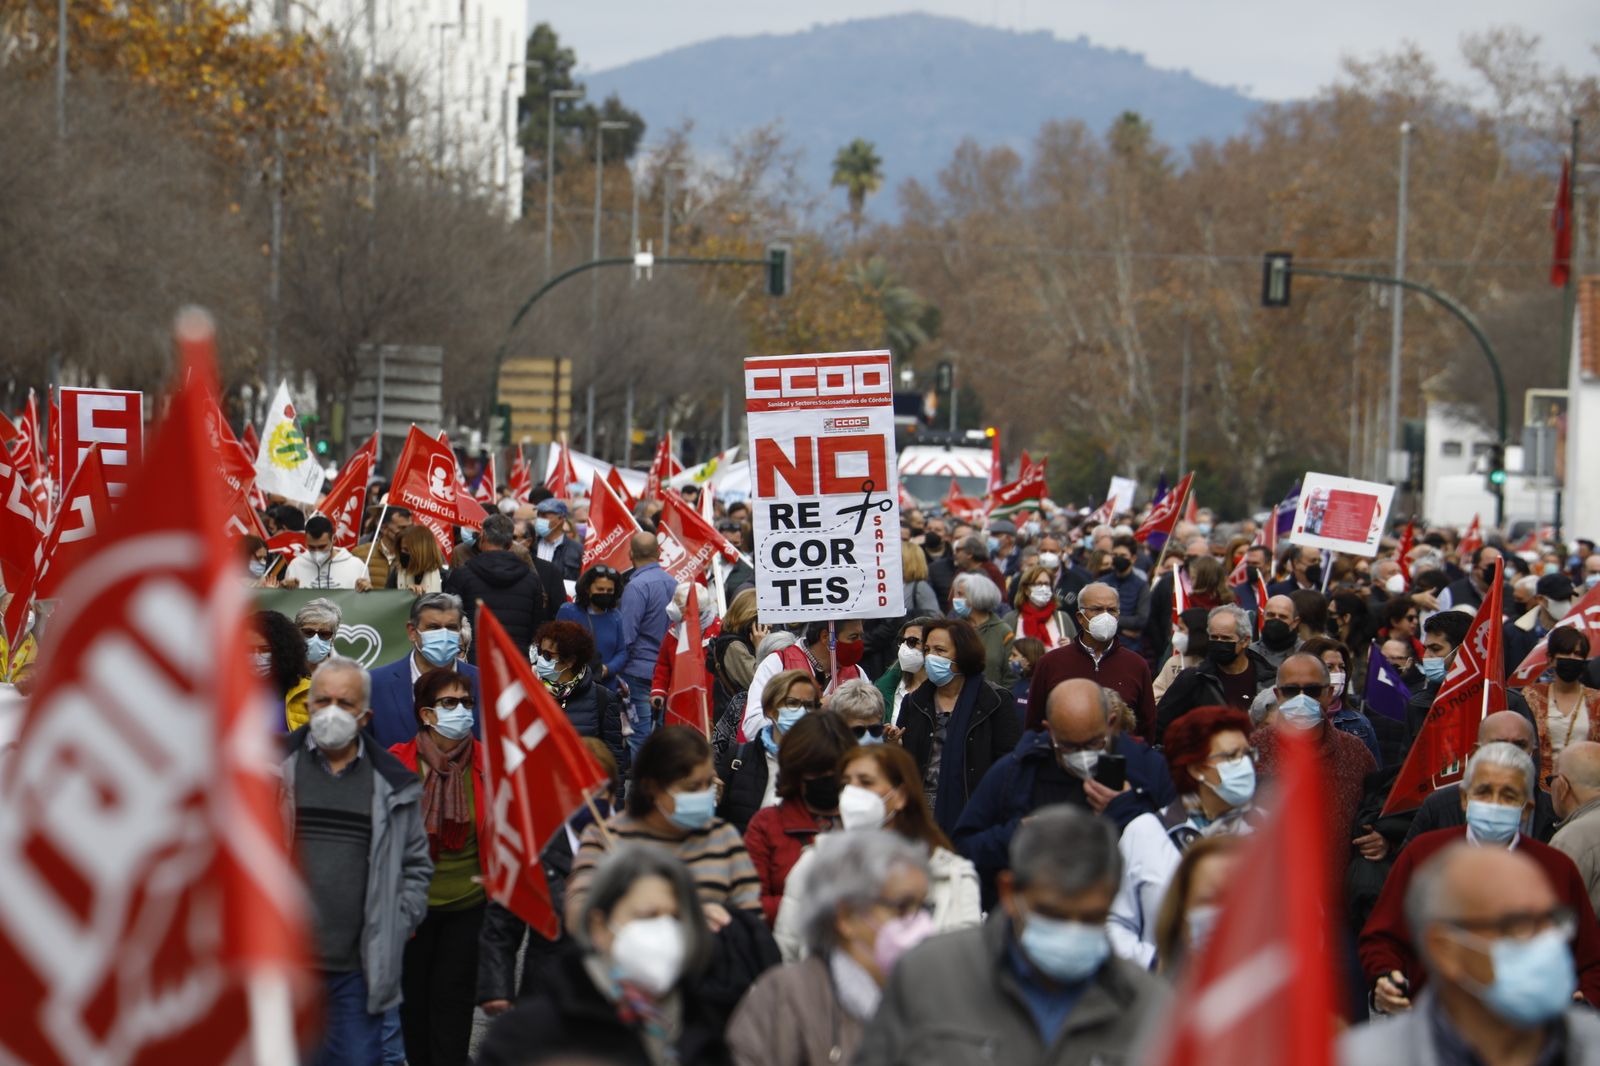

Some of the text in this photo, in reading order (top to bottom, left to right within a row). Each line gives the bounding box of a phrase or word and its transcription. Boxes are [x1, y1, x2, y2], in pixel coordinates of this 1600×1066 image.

[745, 363, 890, 399] CCOO
[768, 400, 789, 408] Sanidad
[755, 434, 888, 497] NO
[402, 489, 455, 519] Izquierda
[769, 501, 822, 530] RE
[430, 522, 453, 555] unida
[771, 537, 857, 568] COR
[873, 515, 887, 607] SANIDAD
[772, 576, 850, 606] TES
